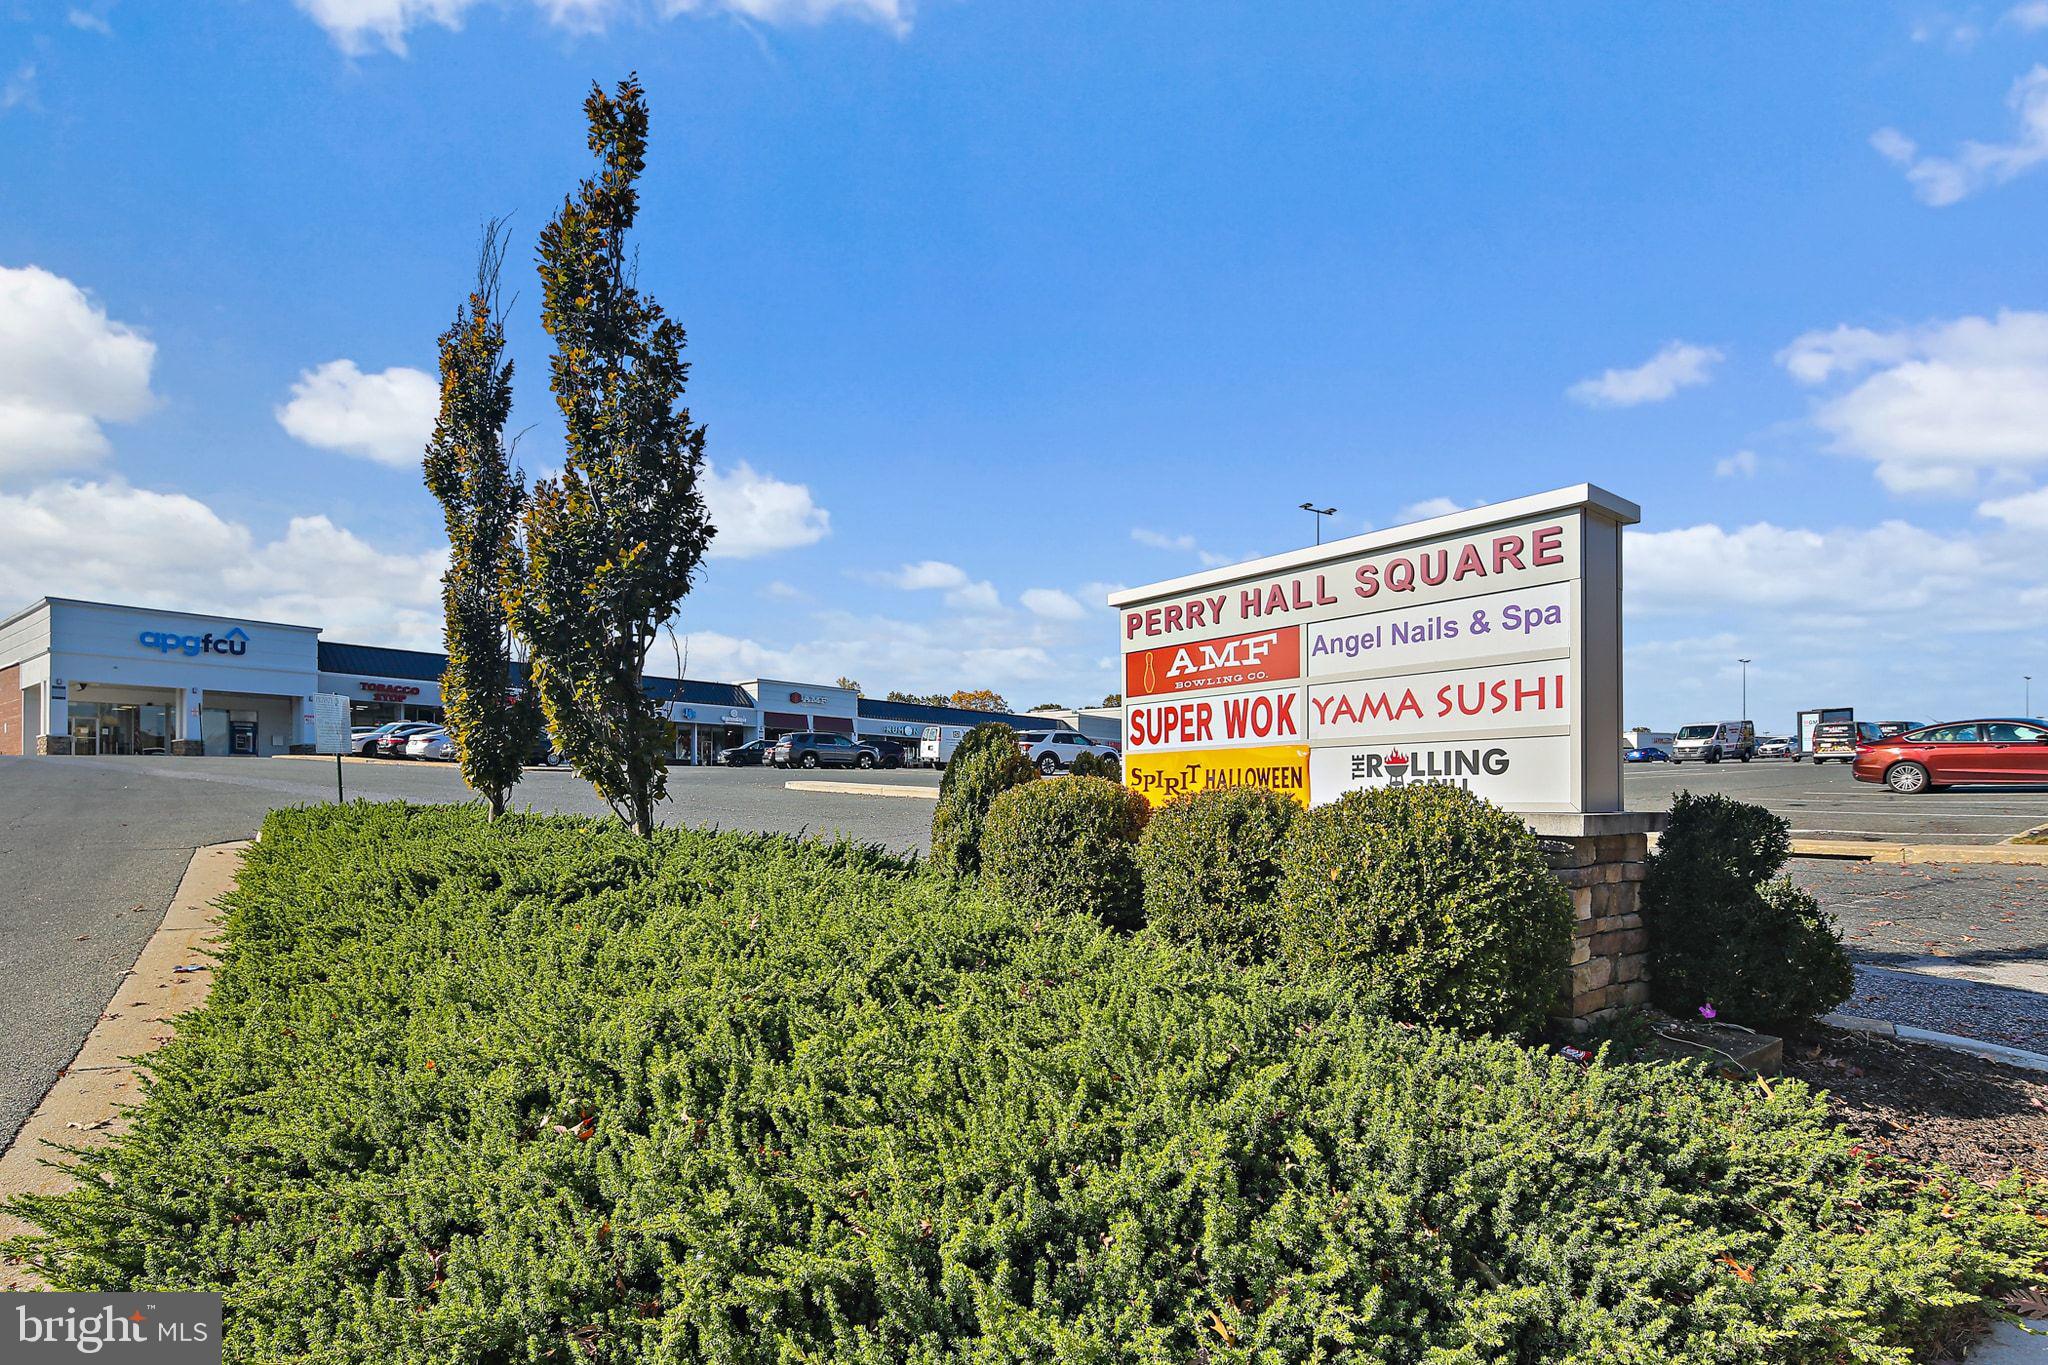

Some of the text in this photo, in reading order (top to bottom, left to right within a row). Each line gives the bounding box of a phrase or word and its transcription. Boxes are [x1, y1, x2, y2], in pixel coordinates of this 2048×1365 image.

[1127, 525, 1564, 640] PERRY HALL SQUARE
[139, 631, 247, 657] apgfcu
[1311, 604, 1562, 658] Angel Nails & Spa
[1166, 632, 1278, 678] AMF
[359, 681, 420, 696] TOBACCO
[1174, 671, 1269, 690] BOWLING CO.
[1311, 674, 1564, 726] YAMA SUSHI
[1129, 692, 1297, 747] SUPER WOK
[1130, 763, 1303, 796] SPIRIT HALLOWEEN
[1351, 753, 1365, 780] THE
